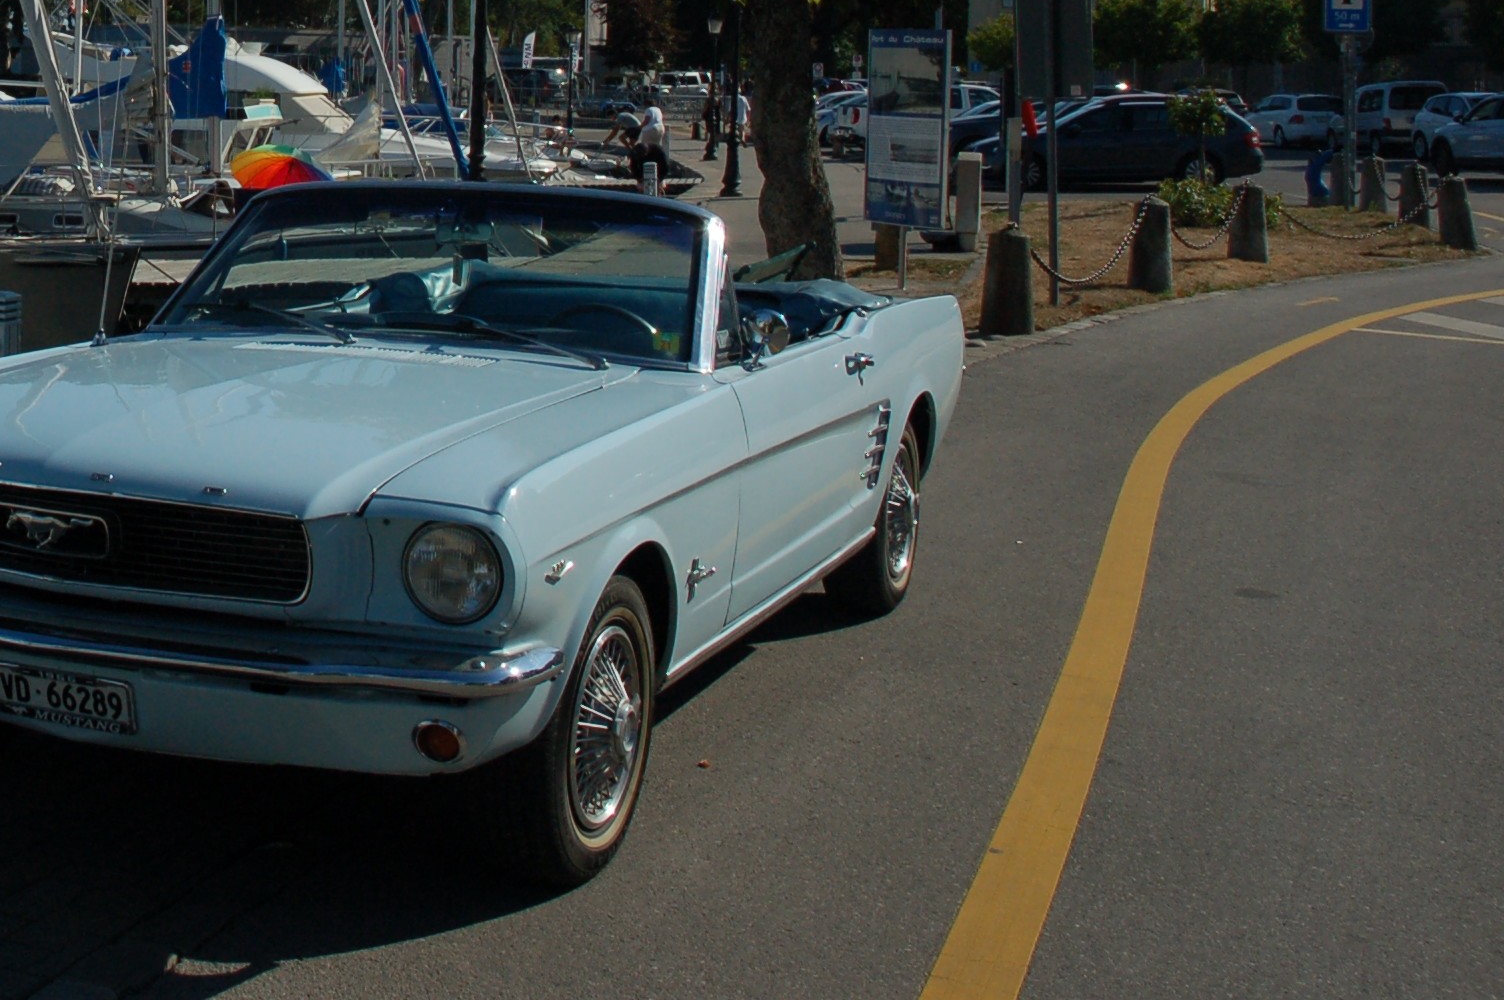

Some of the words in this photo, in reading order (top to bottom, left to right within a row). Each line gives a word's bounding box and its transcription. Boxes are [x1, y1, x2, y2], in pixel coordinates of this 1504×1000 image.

[1334, 11, 1348, 21] 50
[1350, 13, 1361, 21] m
[888, 35, 898, 43] du
[34, 709, 122, 734] MUSTANG
